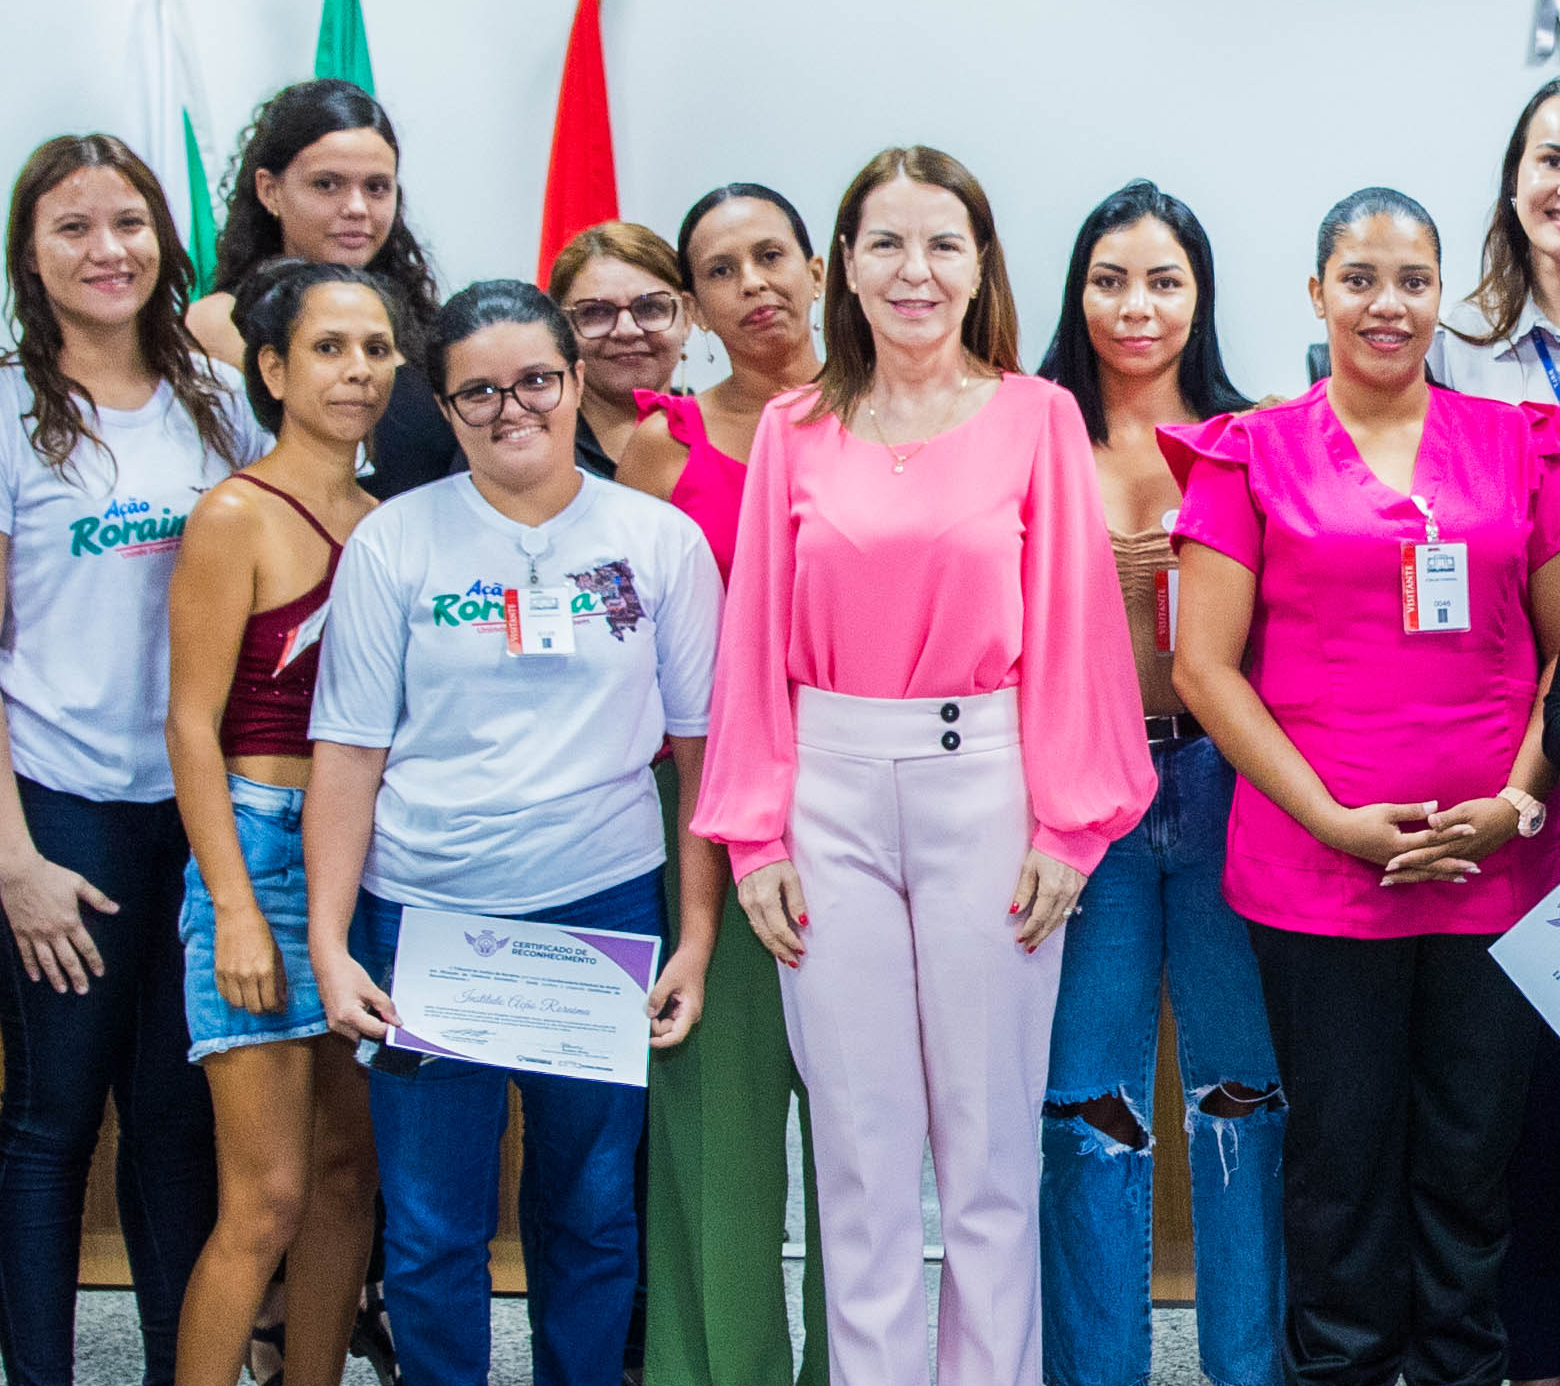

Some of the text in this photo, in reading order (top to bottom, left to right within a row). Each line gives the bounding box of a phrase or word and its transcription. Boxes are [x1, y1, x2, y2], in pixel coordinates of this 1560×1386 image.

[104, 497, 150, 521] Ação
[466, 578, 504, 601] Açã
[1405, 565, 1416, 614] VISITANTE
[511, 948, 597, 965] RECONHECIMENTO
[512, 940, 587, 956] CERTIFICADO DE
